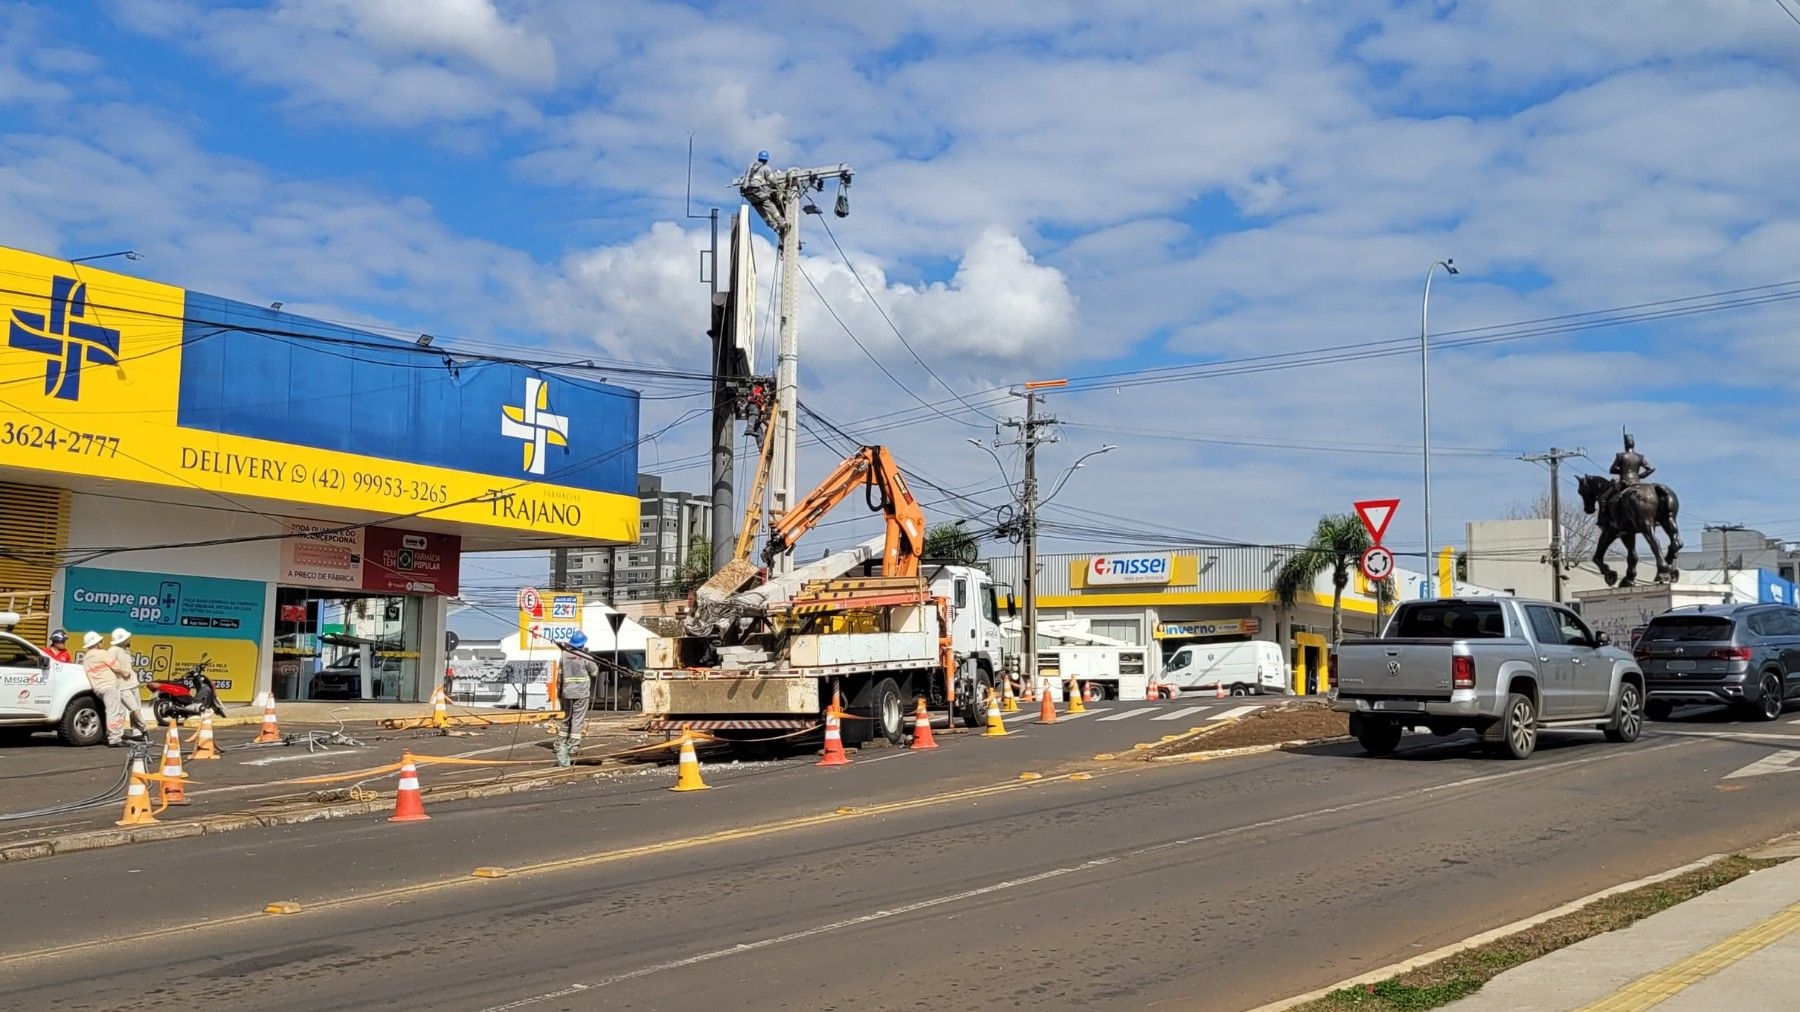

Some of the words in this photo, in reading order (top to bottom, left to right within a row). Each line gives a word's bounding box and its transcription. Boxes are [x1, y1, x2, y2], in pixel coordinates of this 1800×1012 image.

[1, 422, 120, 459] 3624-2777
[181, 446, 287, 482] DELIVERY
[312, 466, 346, 493] (42)
[353, 471, 447, 504] 99953-3265
[487, 489, 582, 527] TRAJANO
[413, 561, 441, 571] POPULAR
[1112, 558, 1166, 575] nissei
[73, 588, 135, 606] Compre
[138, 594, 158, 606] no
[129, 606, 161, 622] app
[1166, 624, 1216, 635] inverno
